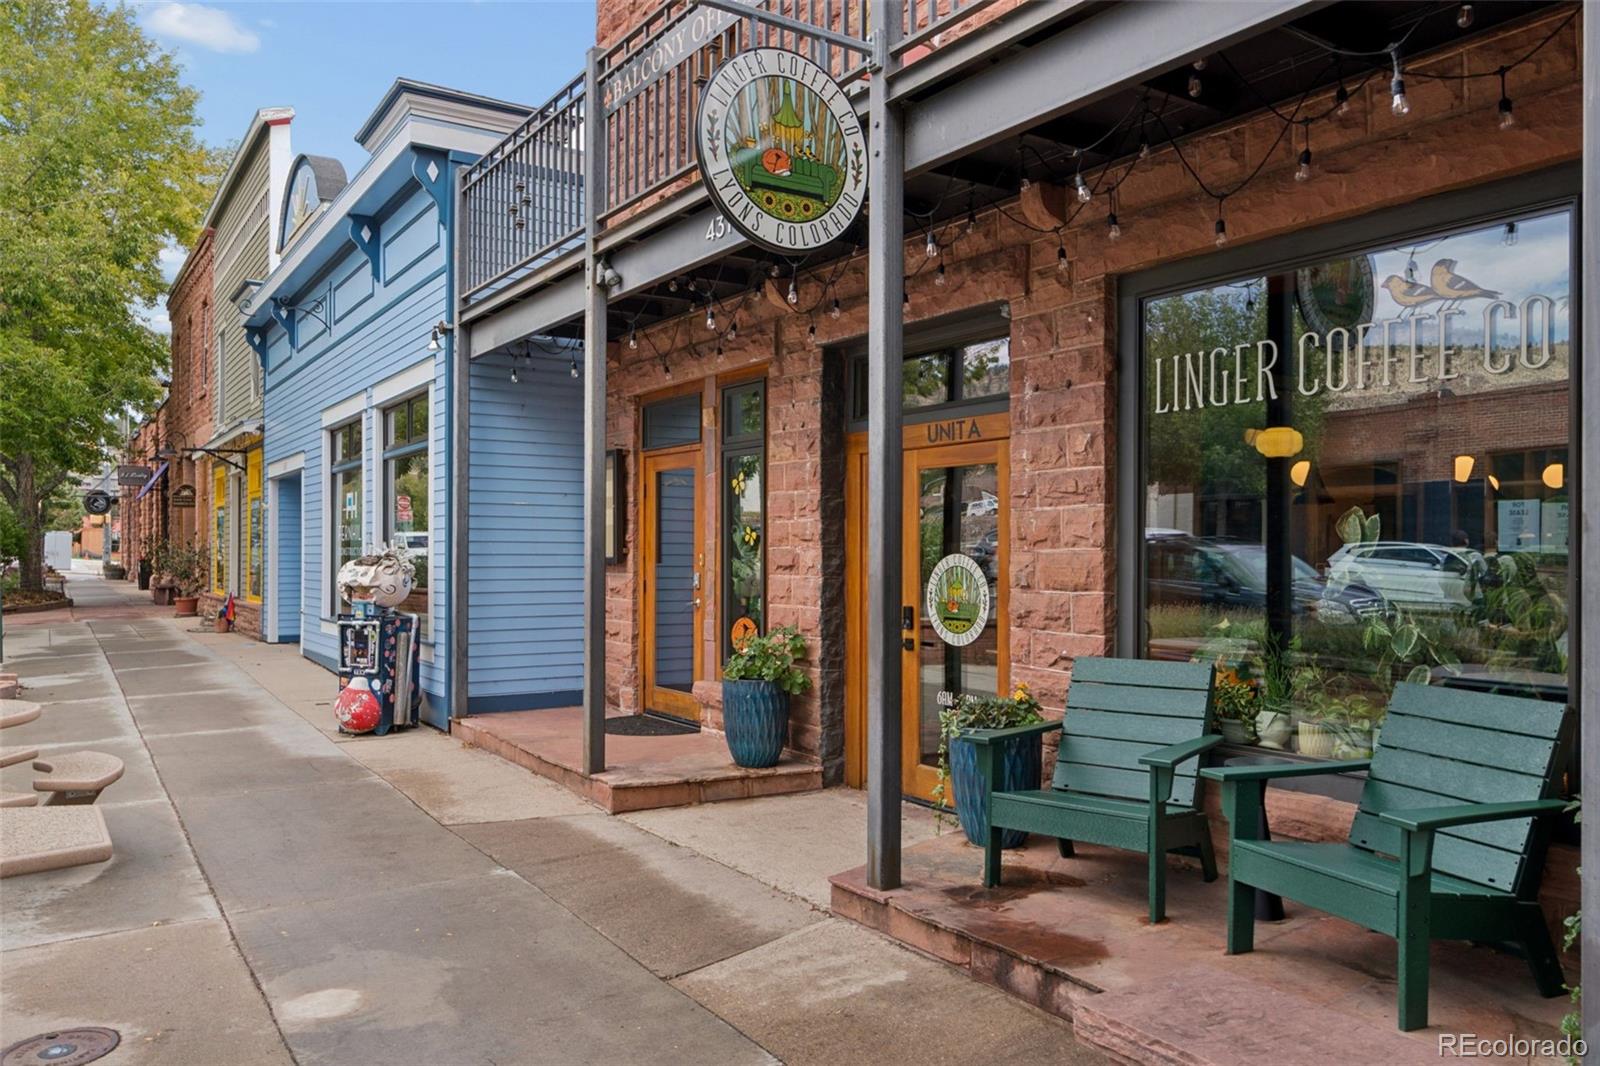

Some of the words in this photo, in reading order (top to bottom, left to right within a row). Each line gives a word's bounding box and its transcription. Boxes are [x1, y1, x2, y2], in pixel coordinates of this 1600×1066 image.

[613, 27, 687, 102] BALCONY
[710, 52, 767, 107] LINGER
[777, 52, 842, 106] COFFEE
[775, 191, 858, 247] COLORADO
[1155, 340, 1278, 413] LINGER
[1298, 309, 1463, 396] COFFEE
[1483, 294, 1556, 373] CO
